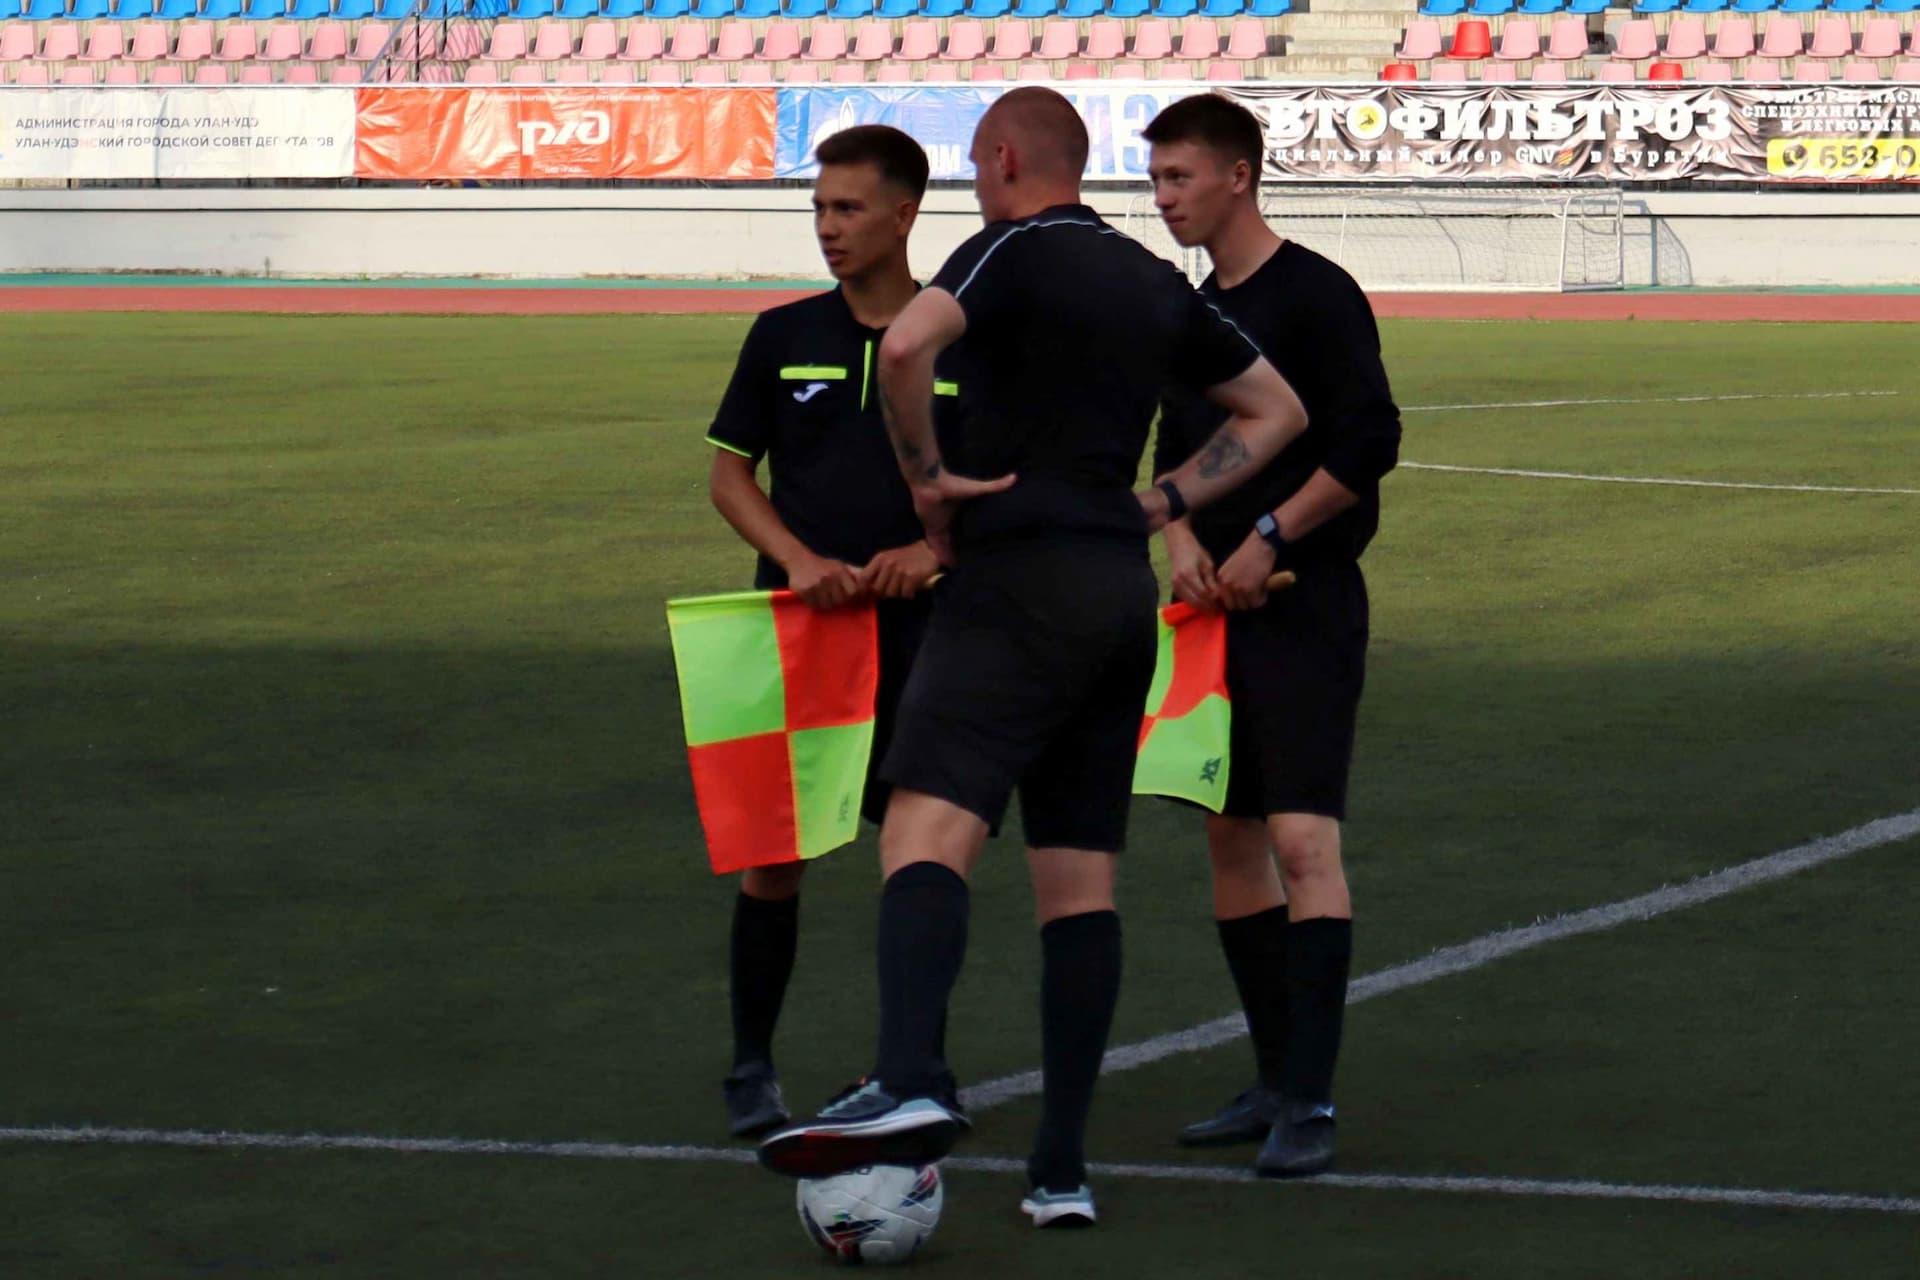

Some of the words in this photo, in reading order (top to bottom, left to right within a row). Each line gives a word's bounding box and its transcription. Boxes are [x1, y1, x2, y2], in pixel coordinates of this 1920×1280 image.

[16, 117, 133, 129] АДМИНИСТРАЦИЯ
[136, 116, 190, 129] ГОРОДА
[127, 134, 208, 148] ГОРОДСКОЙ
[212, 135, 251, 148] СОВЕТ
